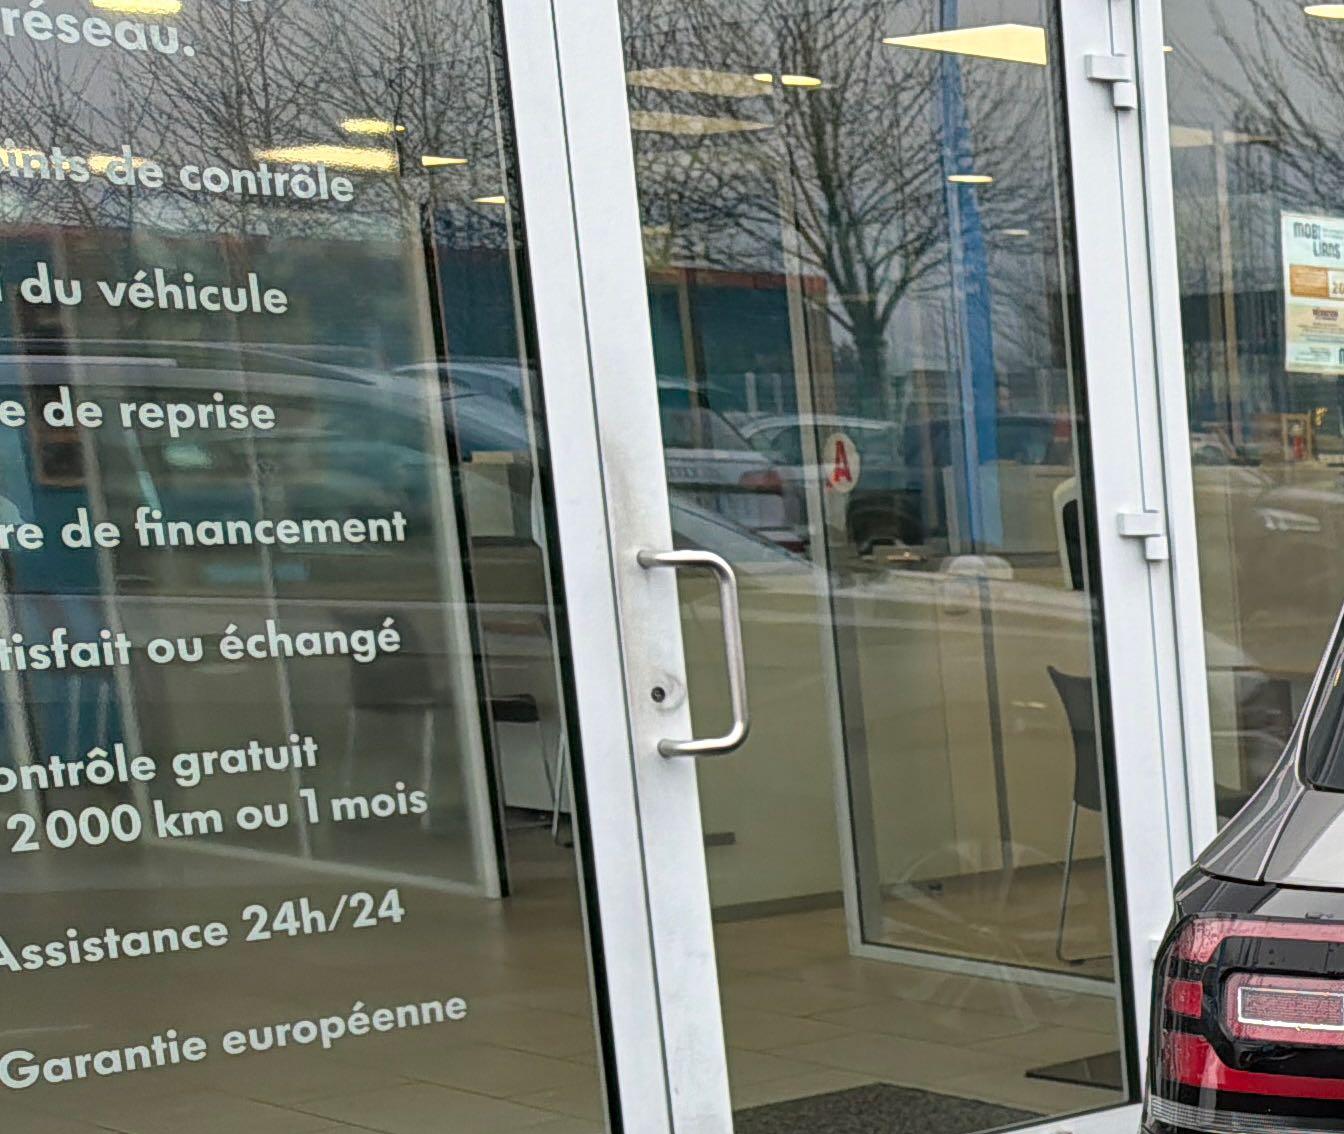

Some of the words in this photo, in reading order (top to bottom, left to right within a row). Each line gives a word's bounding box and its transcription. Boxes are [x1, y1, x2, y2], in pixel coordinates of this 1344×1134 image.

[1, 0, 195, 57] réseau.
[0, 138, 90, 183] ints
[106, 144, 164, 187] de
[179, 164, 355, 202] contrôle
[20, 262, 82, 305] du
[97, 266, 289, 314] véhicule
[43, 386, 103, 428] de
[120, 392, 276, 438] reprise
[61, 507, 121, 548] de
[134, 506, 407, 548] financement
[0, 627, 132, 671] tisfait
[147, 634, 203, 664] ou
[219, 617, 401, 663] échangé
[172, 734, 319, 788] gratuit
[153, 799, 224, 838] km
[236, 802, 289, 831] ou
[300, 788, 320, 824] 1
[331, 781, 428, 821] mois
[241, 889, 405, 942] 24h/24
[0, 1029, 207, 1089] Garantie
[222, 996, 468, 1056] européenne
